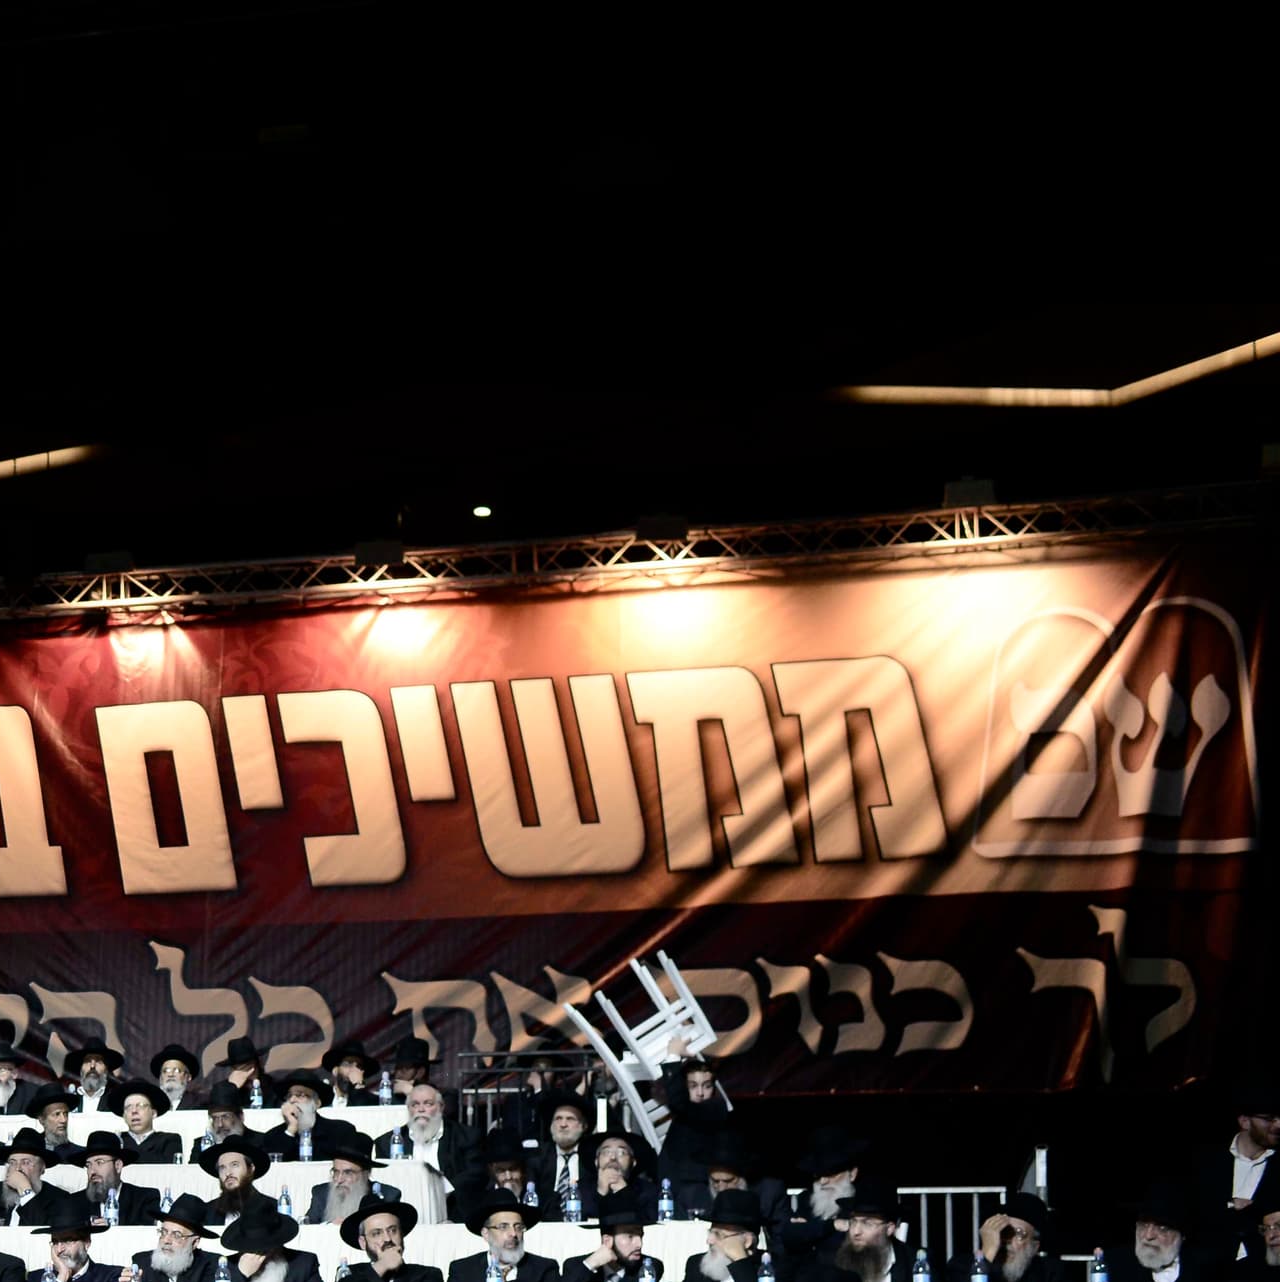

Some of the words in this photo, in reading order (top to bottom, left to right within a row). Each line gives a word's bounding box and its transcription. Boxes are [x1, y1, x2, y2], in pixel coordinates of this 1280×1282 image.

[95, 655, 946, 895] ממשיכים
[149, 941, 334, 1077] כל
[380, 963, 605, 1068] את
[641, 951, 973, 1057] כנוס
[1016, 904, 1198, 1084] לך
